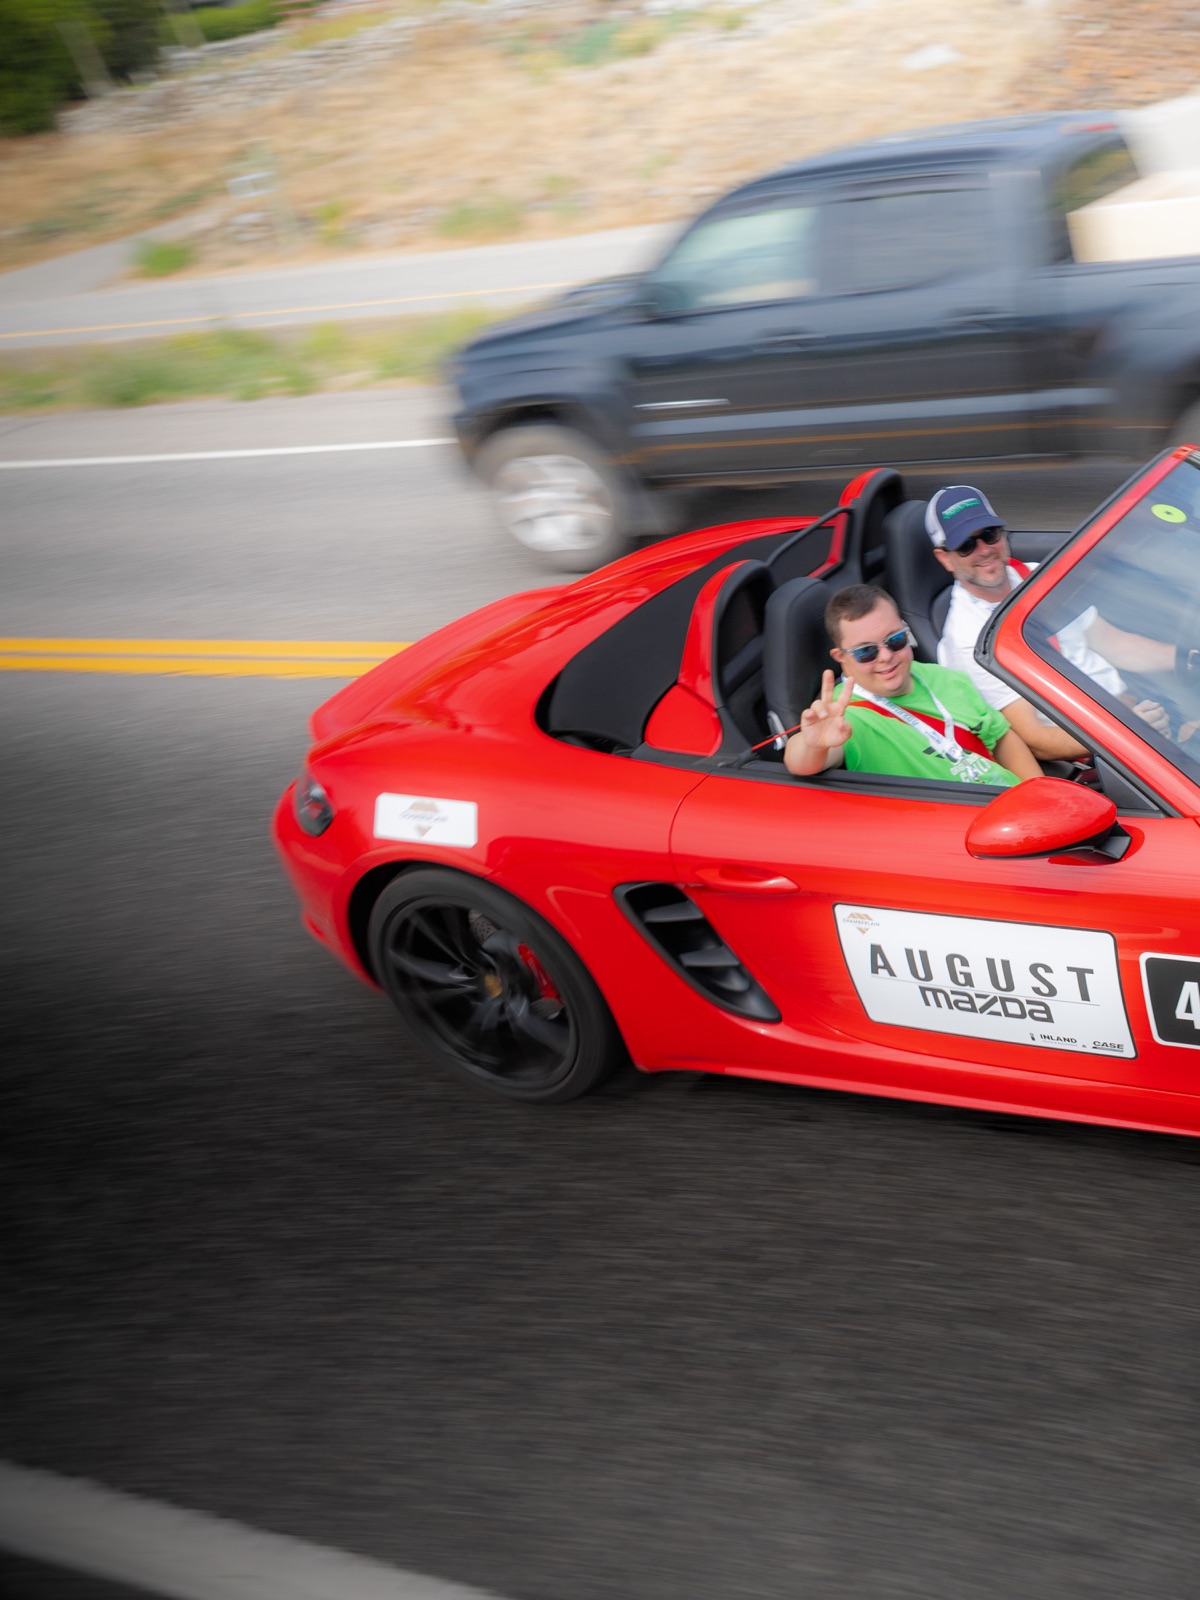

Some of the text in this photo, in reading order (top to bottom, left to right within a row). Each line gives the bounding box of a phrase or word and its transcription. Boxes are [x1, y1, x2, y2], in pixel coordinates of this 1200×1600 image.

[842, 917, 881, 927] CHAMBERLAIN
[869, 942, 1095, 1003] AUGUST
[1039, 1033, 1078, 1044] INLAND
[1093, 1040, 1125, 1050] CASE
